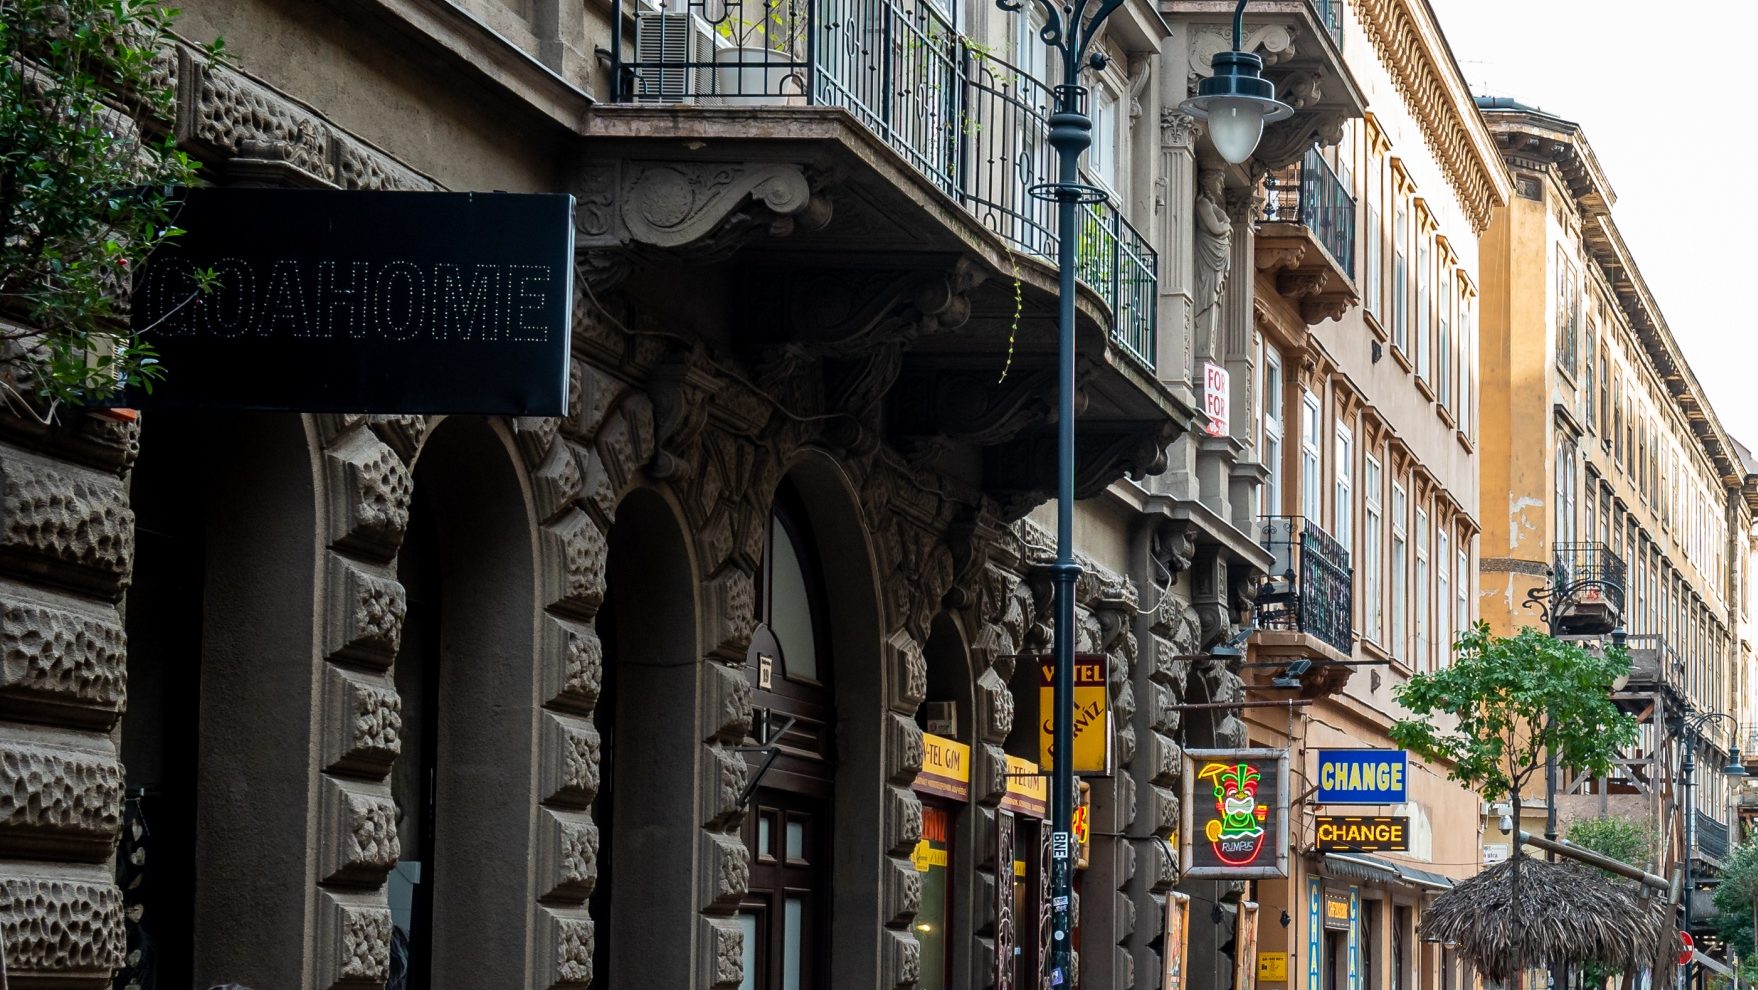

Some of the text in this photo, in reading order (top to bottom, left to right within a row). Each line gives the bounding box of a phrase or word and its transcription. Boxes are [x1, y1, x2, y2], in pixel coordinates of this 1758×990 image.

[147, 256, 551, 342] GOAHOME
[1321, 762, 1403, 791] CHANGE
[1319, 824, 1402, 842] CHANGE
[1053, 834, 1067, 857] BNE
[1222, 841, 1254, 852] RUMPUS
